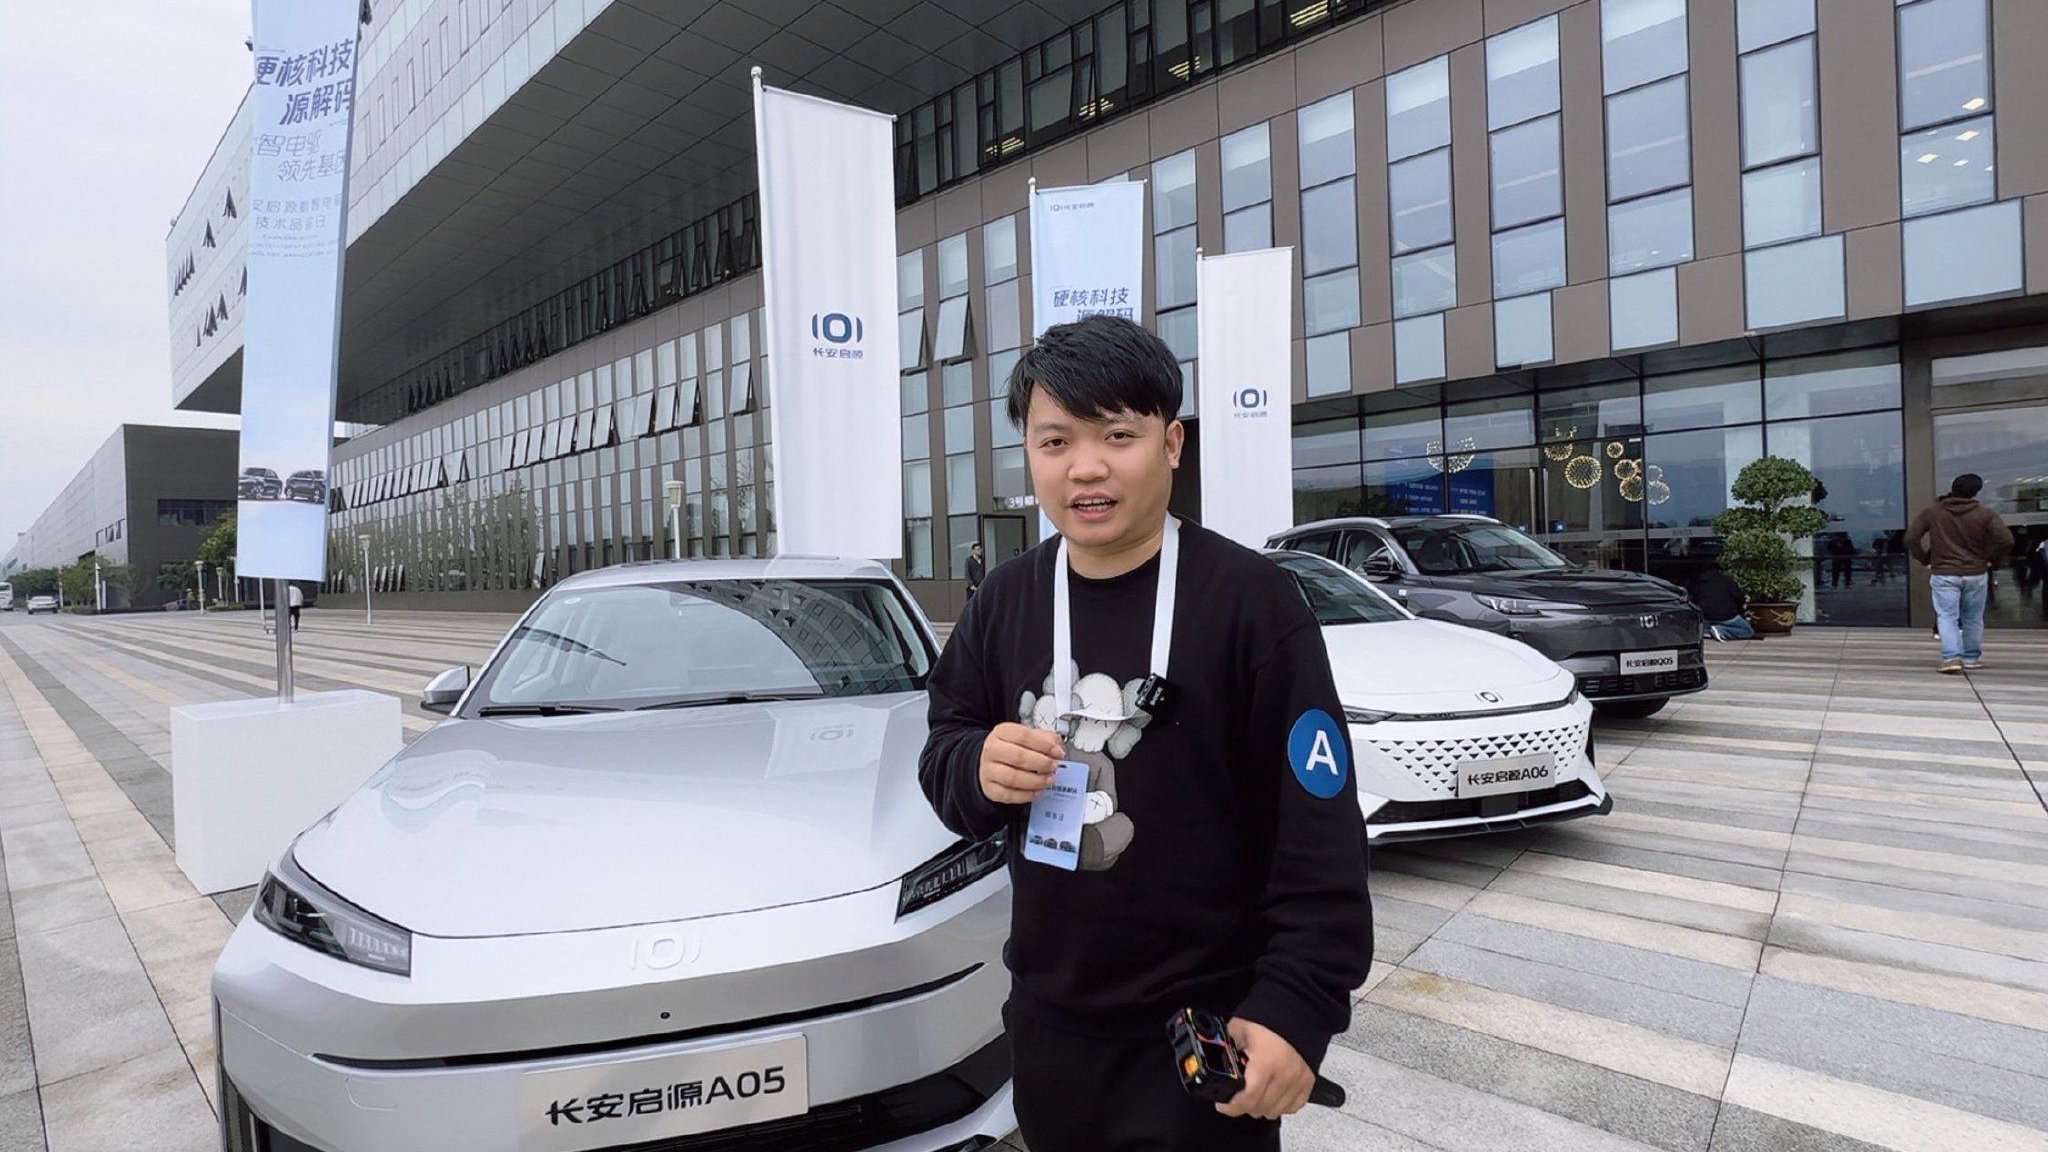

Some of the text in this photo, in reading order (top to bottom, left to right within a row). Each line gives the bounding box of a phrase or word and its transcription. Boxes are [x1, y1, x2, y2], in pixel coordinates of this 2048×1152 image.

[1053, 287, 1129, 307] 硬核科技
[813, 347, 864, 359] 长安启源
[1305, 730, 1339, 776] A
[1467, 765, 1549, 786] 长安启源A06
[545, 1065, 785, 1126] 长安启源A05
